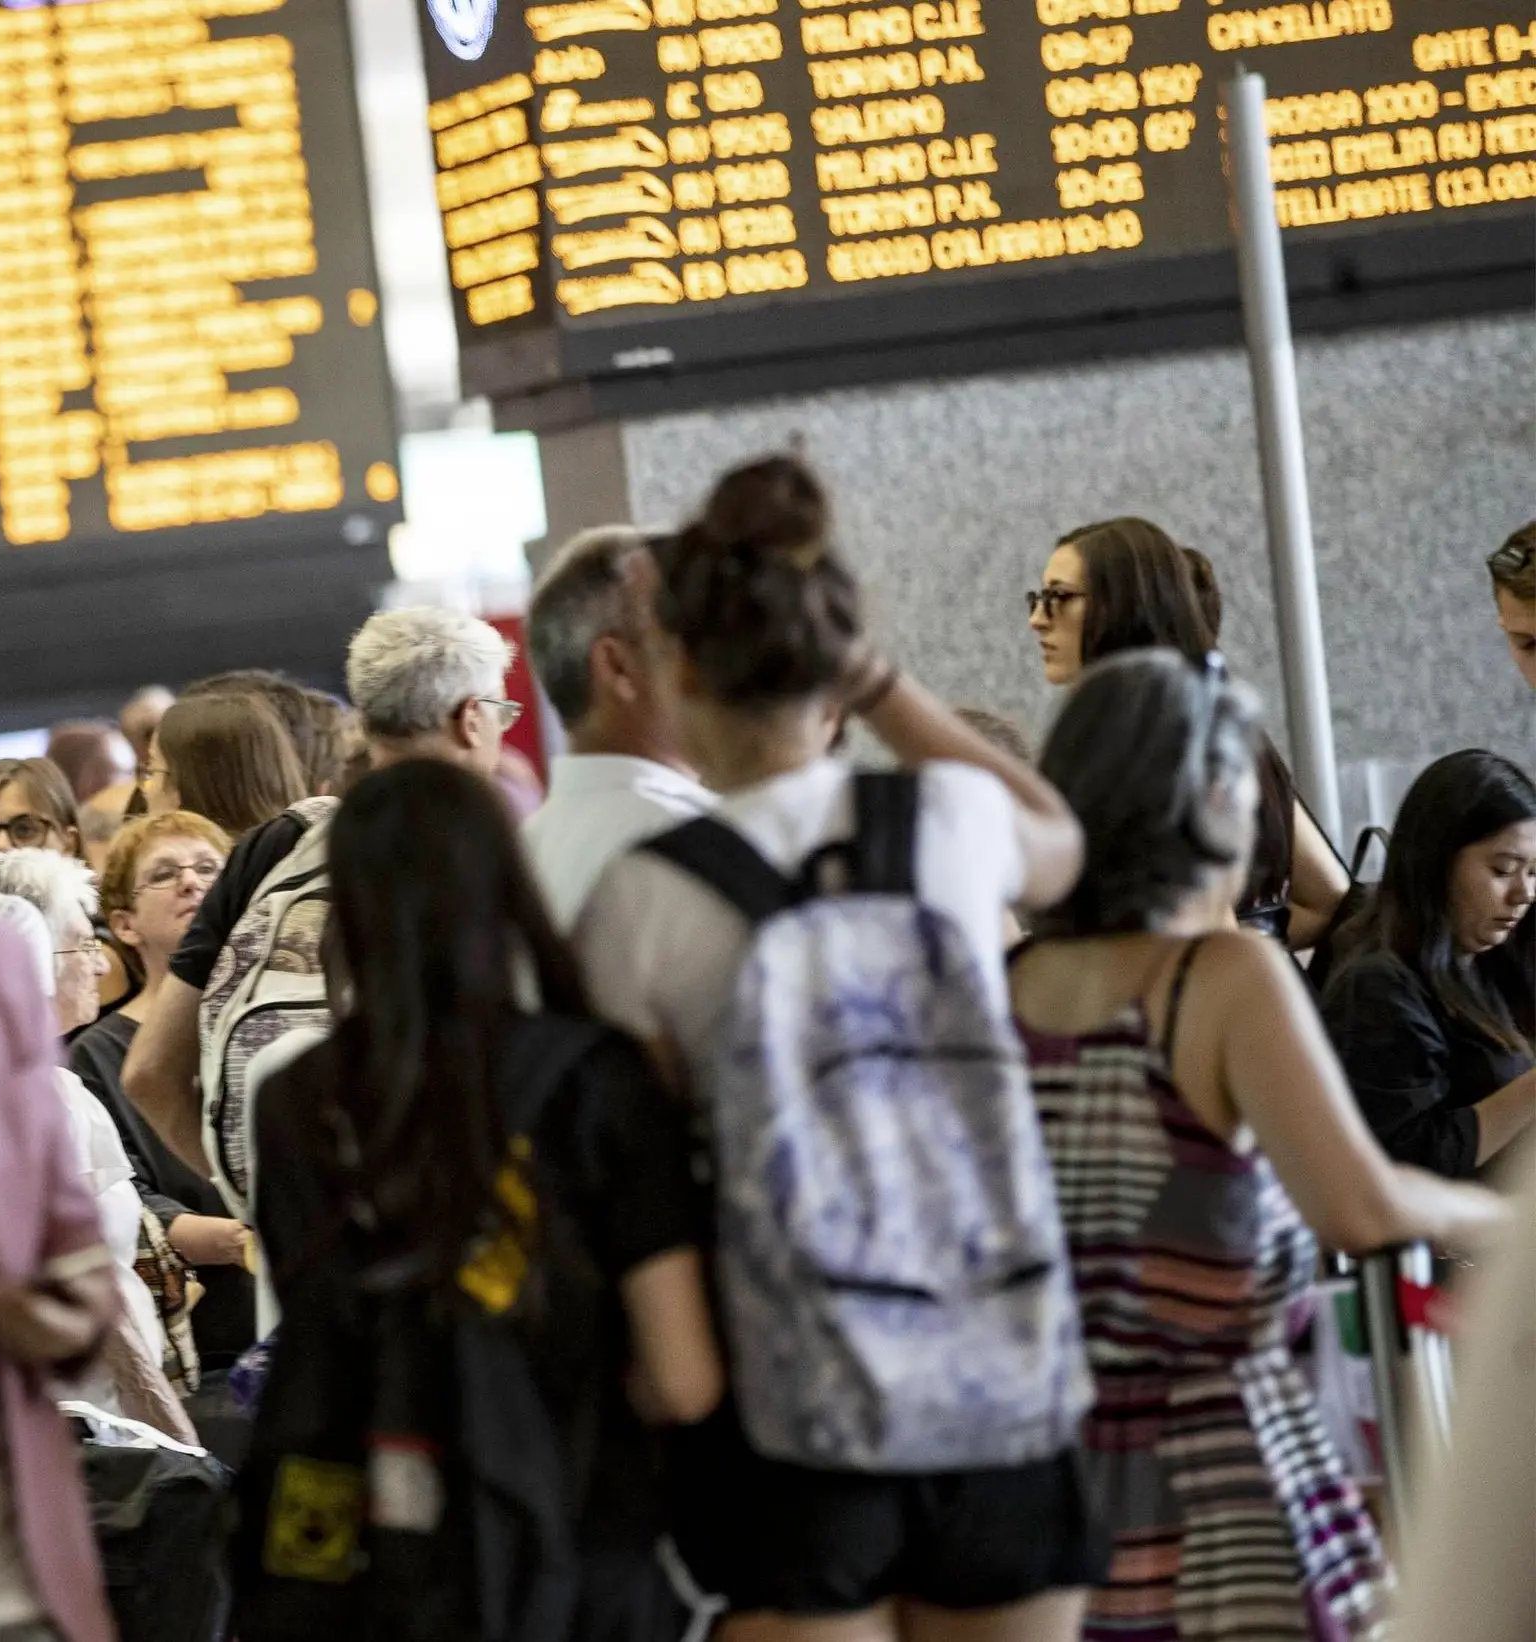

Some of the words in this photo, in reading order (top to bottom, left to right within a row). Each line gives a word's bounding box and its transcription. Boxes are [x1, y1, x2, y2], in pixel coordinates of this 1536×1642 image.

[801, 6, 913, 54] MILANO
[1208, 0, 1392, 51] CANCELLATO
[1413, 28, 1493, 72] GATE
[808, 52, 921, 99] TORINO
[811, 95, 944, 145] SALERNO
[1364, 81, 1438, 124] 1000
[816, 143, 927, 191] MILANO
[1332, 127, 1437, 174] EMILIA
[821, 188, 936, 236] TORINO
